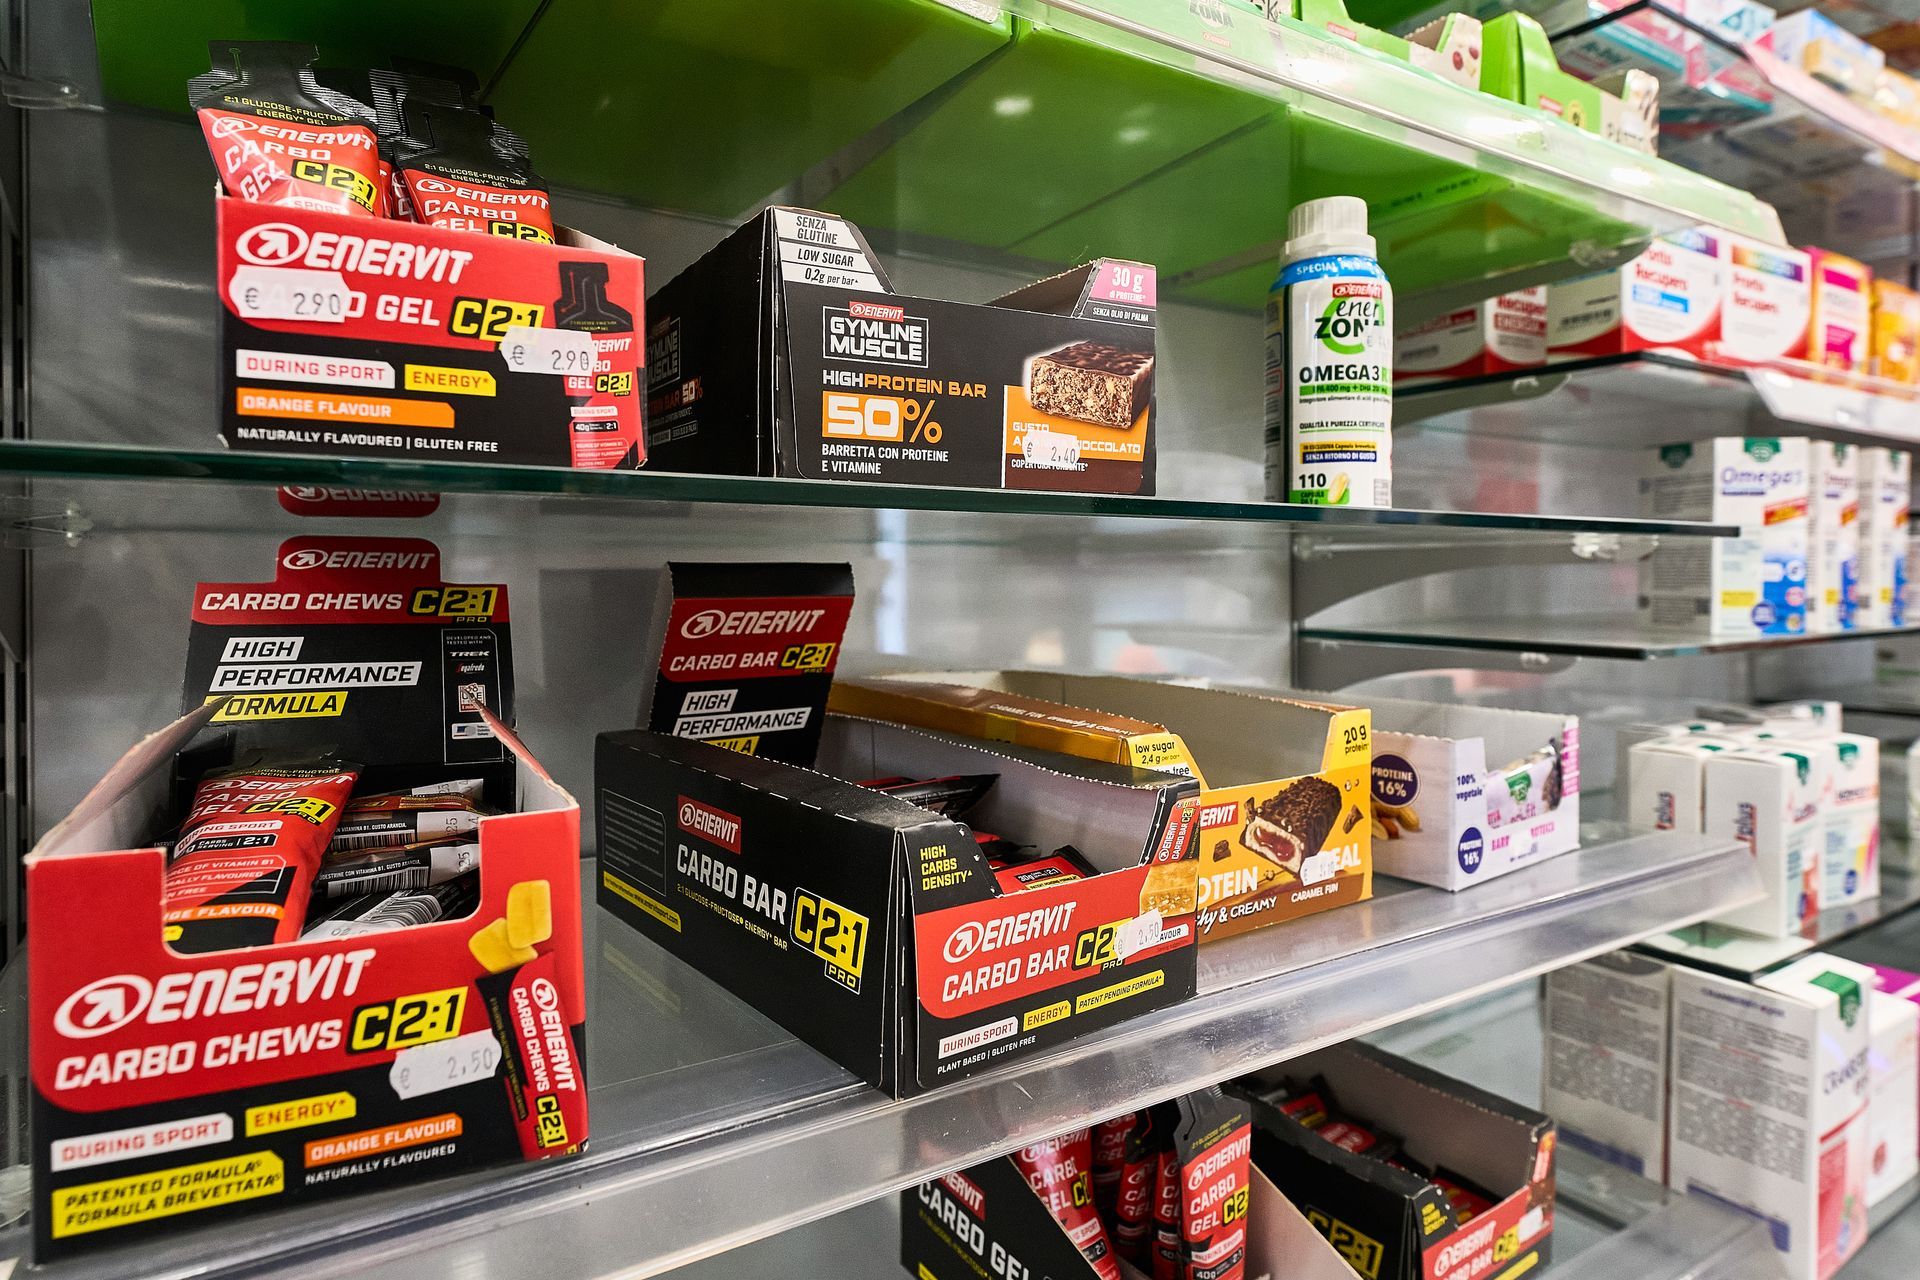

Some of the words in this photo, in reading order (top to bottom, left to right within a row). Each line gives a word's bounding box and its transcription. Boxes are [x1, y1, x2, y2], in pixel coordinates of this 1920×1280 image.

[257, 125, 375, 150] ENERVIT
[224, 139, 331, 174] CARBO
[240, 160, 285, 203] GEL
[424, 199, 517, 221] CARBO
[456, 189, 549, 210] ENERVIT
[796, 216, 827, 231] SENZA
[797, 228, 838, 245] GLUTINE
[302, 238, 473, 284] ENERVIT
[797, 248, 820, 261] LOW
[822, 252, 854, 267] SUGAR
[804, 267, 825, 283] 0,2g
[827, 274, 840, 284] per
[1112, 266, 1130, 287] 30
[1132, 274, 1144, 293] g
[245, 287, 260, 311] €
[1336, 300, 1379, 318] ener
[375, 295, 440, 326] GEL
[864, 306, 903, 320] ENERVIT
[1093, 307, 1110, 317] SENZA
[1111, 309, 1123, 319] OLIO
[1124, 311, 1130, 319] DI
[1131, 312, 1149, 322] PALMA
[830, 316, 922, 343] GYMLINE
[1314, 316, 1379, 339] ZON
[510, 345, 525, 365] €
[830, 335, 922, 361] MUSCLE
[247, 357, 323, 377] DURING
[328, 362, 386, 382] SPORT
[1299, 364, 1370, 384] OMEGA
[1372, 365, 1380, 381] 3
[568, 377, 593, 389] GEL
[597, 373, 632, 392] C2:1
[948, 381, 987, 398] BAR
[243, 394, 312, 415] ORANGE
[318, 399, 391, 418] FLAVOUR
[827, 395, 943, 444] 50%
[1012, 421, 1050, 432] GUSTO
[237, 427, 321, 444] NATURALLY
[324, 431, 403, 448] FLAVOURED
[414, 438, 464, 451] GLUTEN
[467, 441, 499, 452] FREE
[822, 444, 875, 459] BARRETTA
[878, 446, 899, 459] CON
[902, 449, 949, 462] PROTEINE
[822, 460, 828, 471] E
[831, 461, 882, 474] VITAMINE
[1299, 473, 1327, 488] 110
[326, 552, 435, 569] ENERVIT
[201, 593, 301, 611] CARBO
[304, 593, 403, 611] CHEWS
[411, 588, 498, 616] C2:1
[720, 610, 826, 636] ENERVIT
[229, 641, 296, 658] HIGH
[669, 653, 738, 673] CARBO
[739, 651, 779, 669] BAR
[218, 665, 415, 688] PERFORMANCE
[226, 694, 338, 716] ORMULA
[686, 693, 732, 711] HIGH
[679, 710, 807, 737] PERFORMANCE
[1027, 711, 1045, 719] FUN
[1344, 728, 1357, 746] 20
[1358, 723, 1367, 743] g
[1135, 743, 1150, 754] low
[1152, 740, 1175, 752] sugar
[1142, 755, 1154, 765] 2,4
[1155, 755, 1161, 765] g
[1172, 766, 1190, 776] free
[239, 774, 353, 791] ENERVIT
[1372, 767, 1413, 782] PROTEINE
[1456, 774, 1476, 785] 100%
[1377, 780, 1407, 798] 16%
[1456, 788, 1483, 801] vegetale
[244, 797, 337, 822] C2:1
[178, 826, 224, 852] DURING
[227, 821, 277, 830] SPORT
[694, 809, 739, 844] ENERVIT
[243, 836, 271, 845] 2:1
[212, 860, 259, 868] VITAMIN
[919, 845, 947, 861] HIGH
[202, 872, 264, 881] FLAVOURED
[921, 860, 958, 876] CARBS
[1291, 886, 1324, 902] CARAMEL
[1325, 883, 1339, 896] FUN
[197, 904, 279, 918] FLAVOUR
[676, 844, 738, 899] CARBO
[743, 875, 787, 925] BAR
[794, 894, 870, 970] C2:1
[1230, 896, 1277, 918] CREAMY
[981, 901, 1077, 950] ENERVIT
[773, 935, 788, 951] BAR
[828, 964, 857, 988] PRO
[942, 958, 1020, 1003] CARBO
[1026, 945, 1070, 980] BAR
[1102, 959, 1123, 971] PRO
[146, 949, 377, 1025] ENERVIT
[943, 1033, 981, 1053] DURING
[983, 1022, 1014, 1042] SPORT
[1079, 994, 1103, 1009] PATENT
[1104, 985, 1131, 1001] PENDING
[54, 1041, 198, 1091] CARBO
[203, 1019, 343, 1069] CHEWS
[351, 987, 468, 1051] C2:1
[512, 987, 538, 1038] CARBO
[526, 1038, 551, 1092] CHEWS
[539, 1010, 577, 1092] ENERVIT
[937, 1059, 961, 1075] PLANT
[963, 1052, 986, 1066] BASED
[991, 1041, 1018, 1057] GLUTEN
[1019, 1035, 1037, 1049] FREE
[62, 1134, 146, 1162] DURING
[152, 1120, 223, 1146] SPORT
[311, 1134, 380, 1161] ORANGE
[384, 1117, 457, 1145] FLAVOUR
[305, 1159, 381, 1186] NATURALLY
[384, 1143, 456, 1169] FLAVOURED
[1205, 1133, 1251, 1178] ENERVIT
[65, 1176, 163, 1209] PATENTED
[1190, 1172, 1236, 1215] CARBO
[65, 1197, 157, 1228] FORMULA
[919, 1180, 985, 1256] CARBO
[1190, 1211, 1220, 1235] GEL
